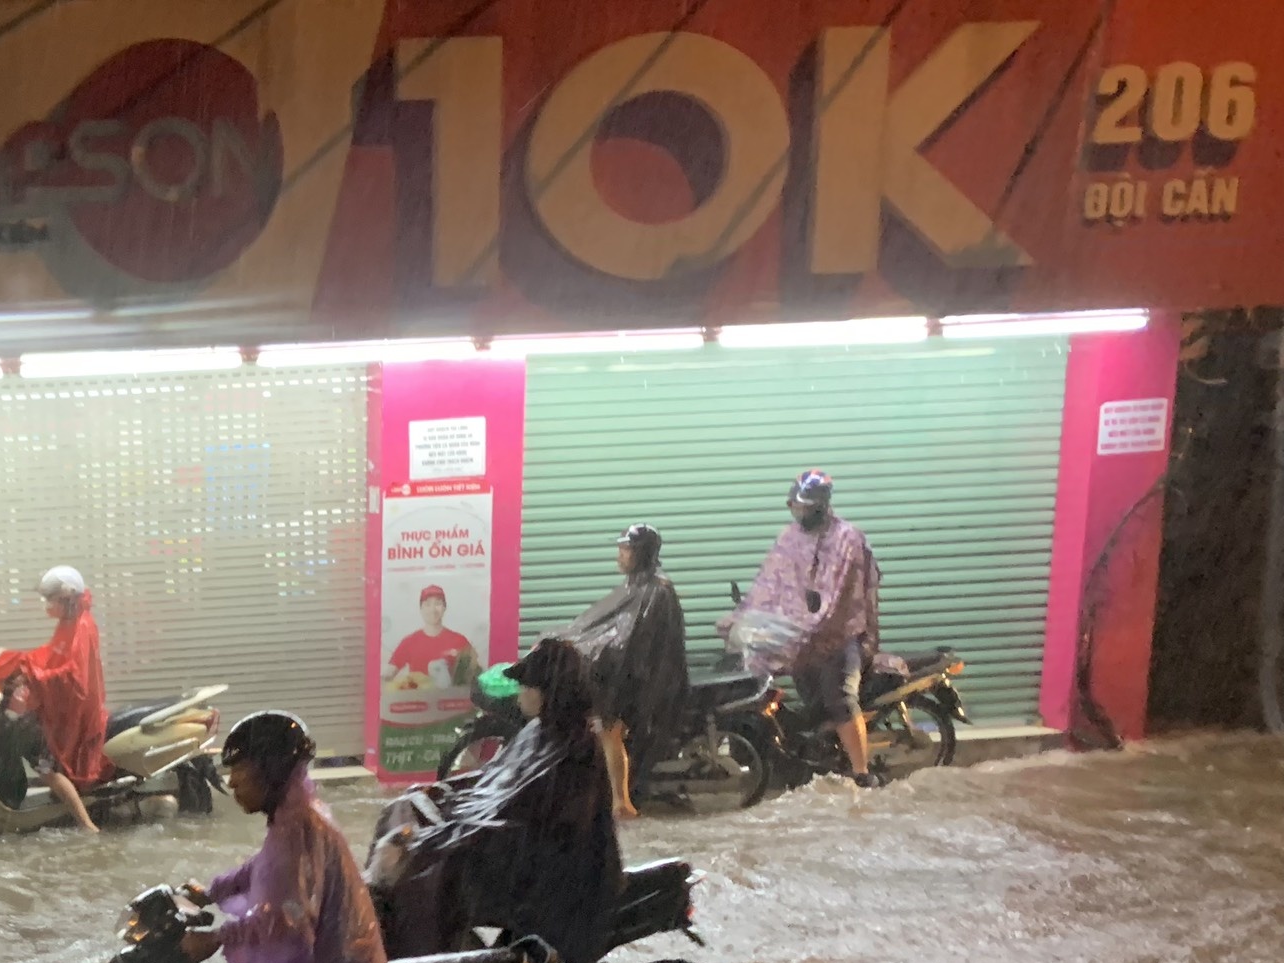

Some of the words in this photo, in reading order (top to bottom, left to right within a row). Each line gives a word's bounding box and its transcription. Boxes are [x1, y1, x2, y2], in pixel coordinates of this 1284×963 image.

[1092, 61, 1258, 145] 206
[396, 20, 1041, 288] 10K
[387, 543, 425, 560] BÌNH
[457, 539, 485, 557] GIÁ
[401, 530, 432, 543] THỰC
